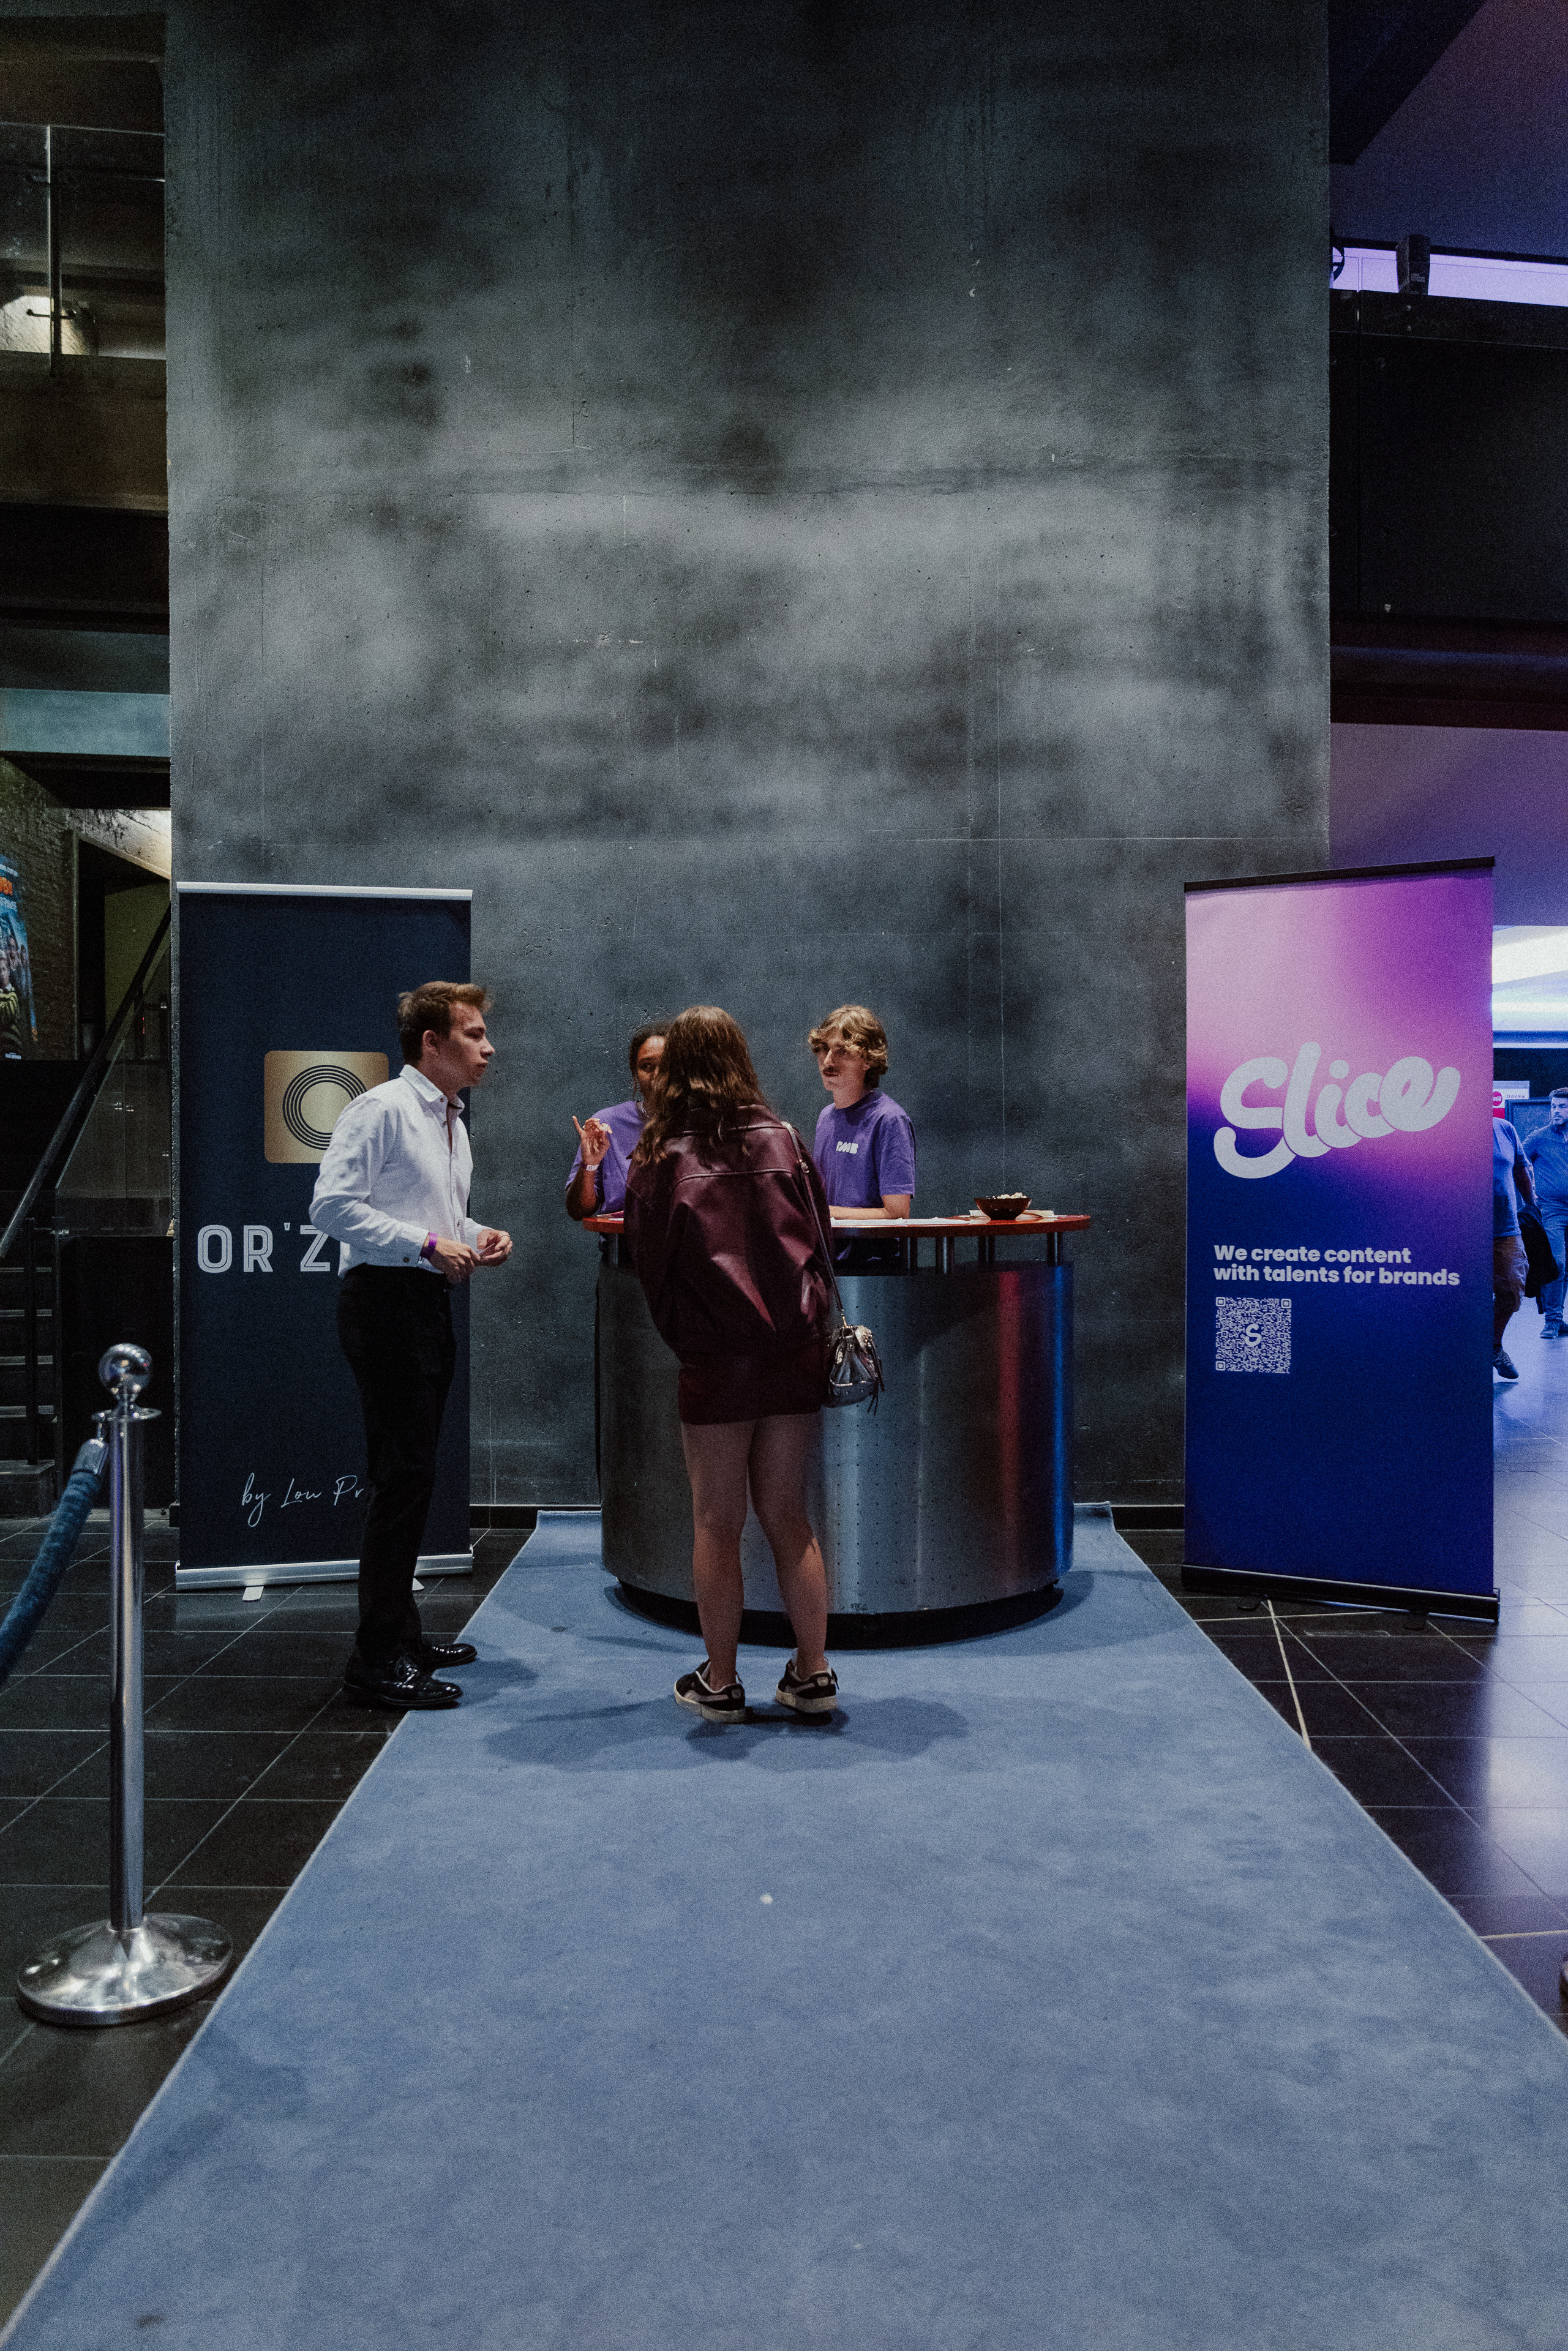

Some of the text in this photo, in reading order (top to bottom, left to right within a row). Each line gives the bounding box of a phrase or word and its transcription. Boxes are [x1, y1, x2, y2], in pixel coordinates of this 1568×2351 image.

[1214, 1041, 1460, 1179] Slice
[1214, 1245, 1411, 1264] We create content
[1214, 1263, 1460, 1286] with talents for brands
[242, 1472, 271, 1527] by
